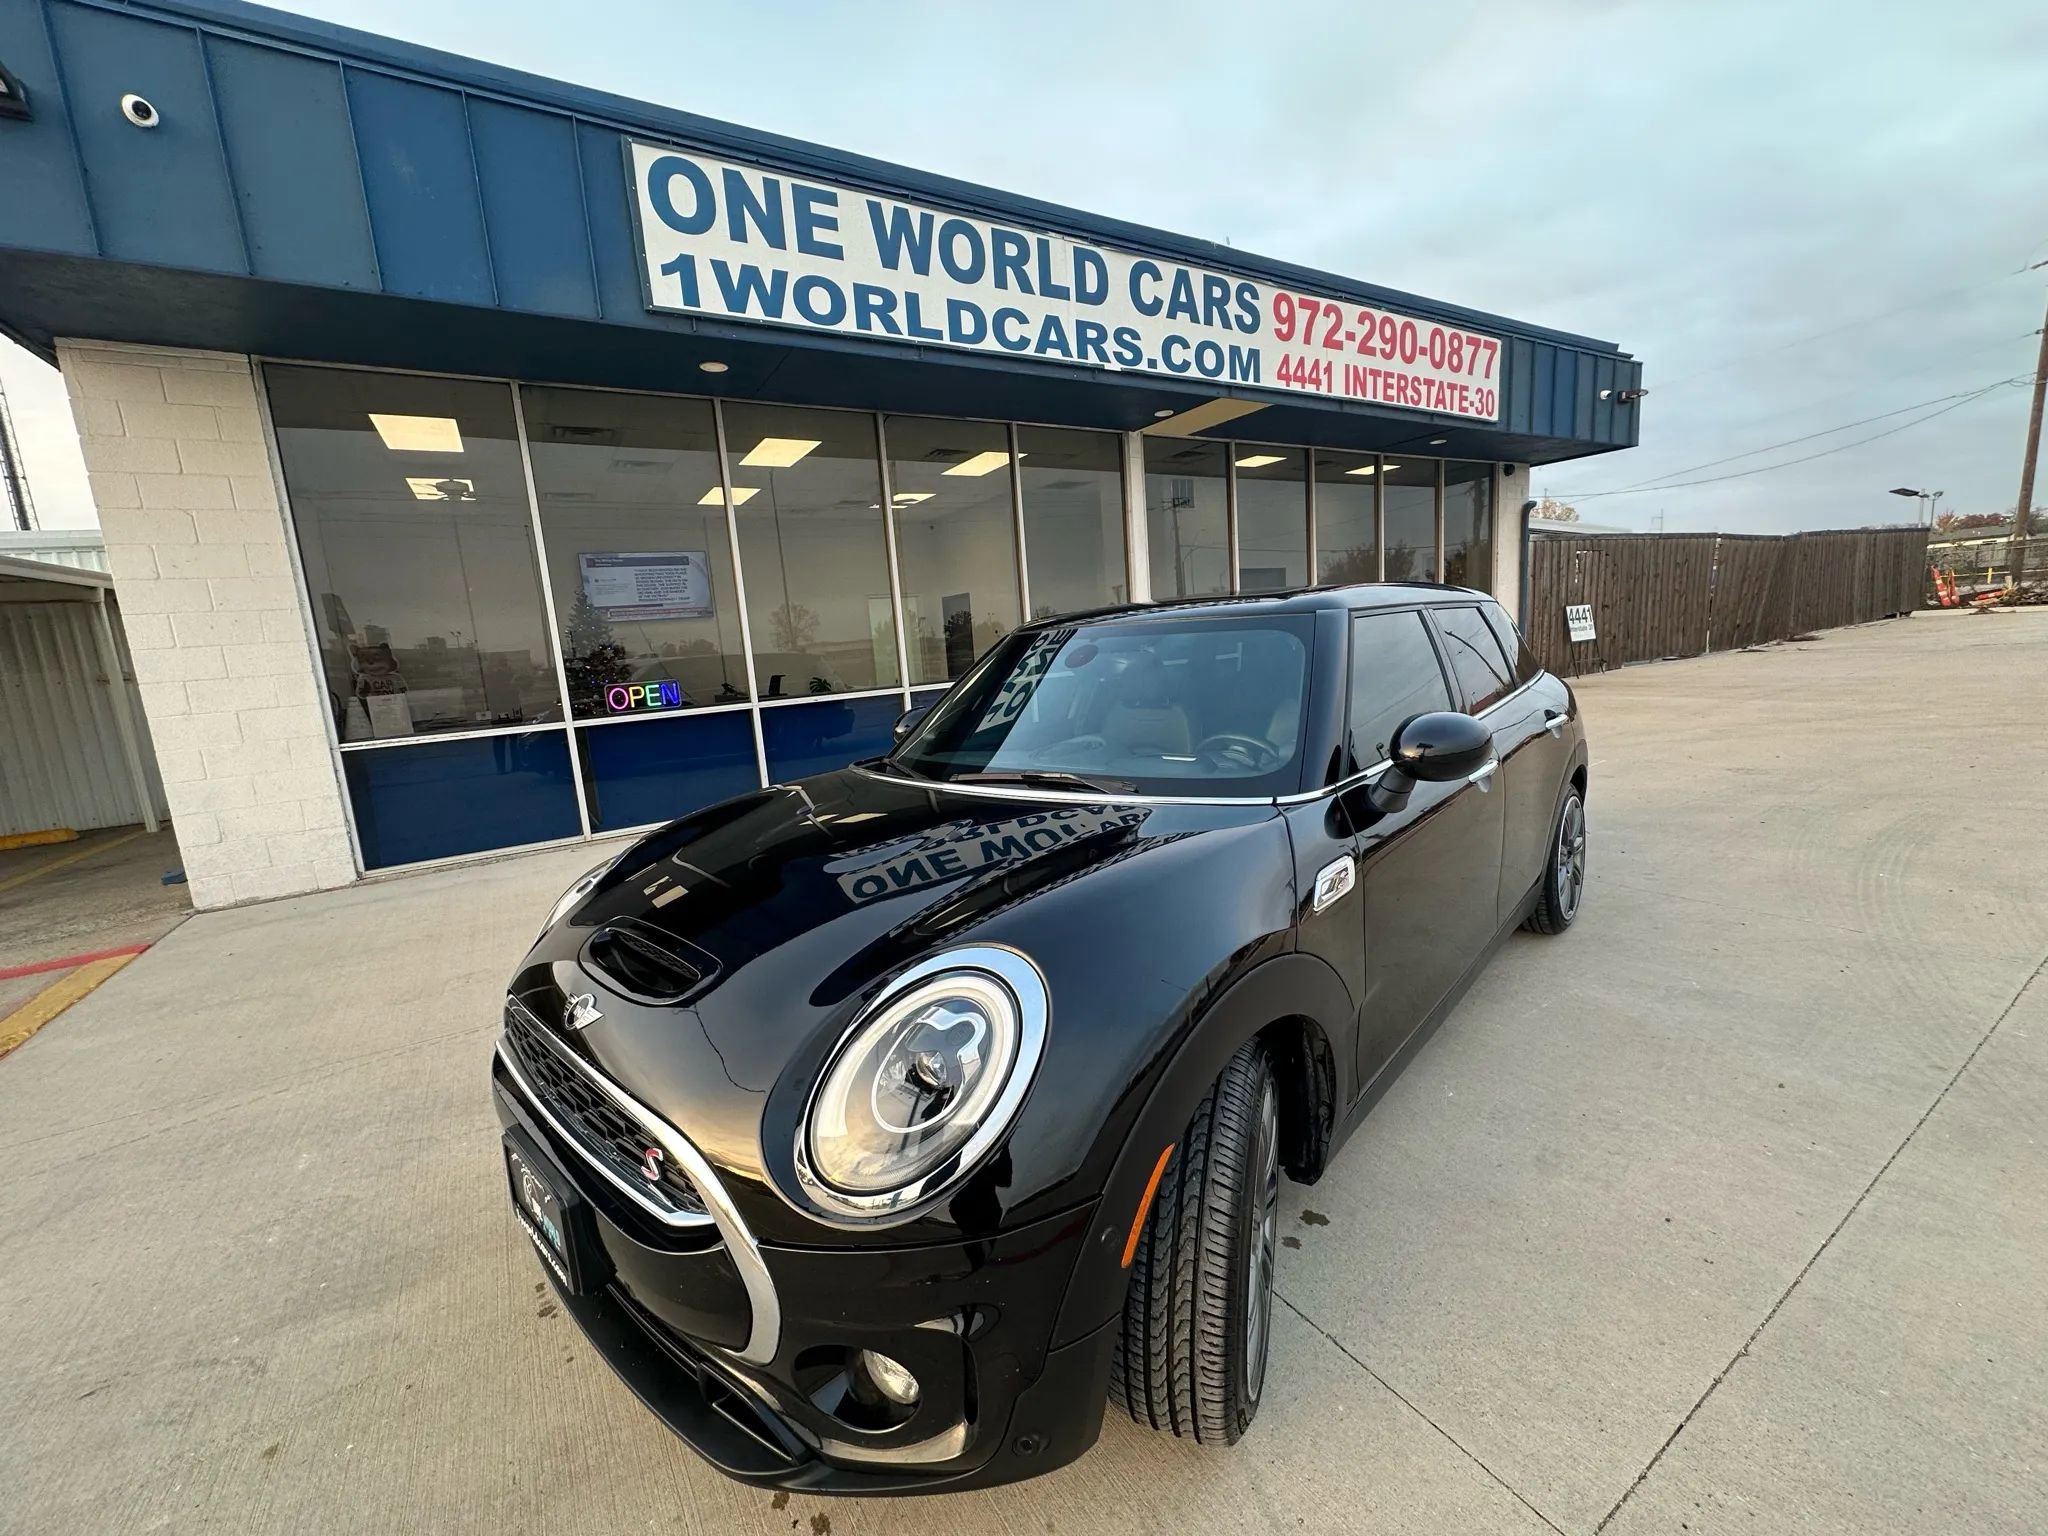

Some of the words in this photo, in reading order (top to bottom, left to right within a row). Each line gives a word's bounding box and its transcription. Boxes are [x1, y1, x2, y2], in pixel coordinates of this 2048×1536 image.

[648, 155, 844, 261] ONE
[866, 199, 1109, 306] WORLD
[1129, 259, 1261, 334] CARS
[661, 253, 1261, 384] 1WORLDCARS.COM
[1272, 292, 1499, 380] 972-290-0877
[1277, 353, 1334, 393] 4441
[1344, 363, 1496, 418] INTERSTATE-30
[1569, 606, 1592, 624] 4441
[609, 682, 679, 710] OPEN
